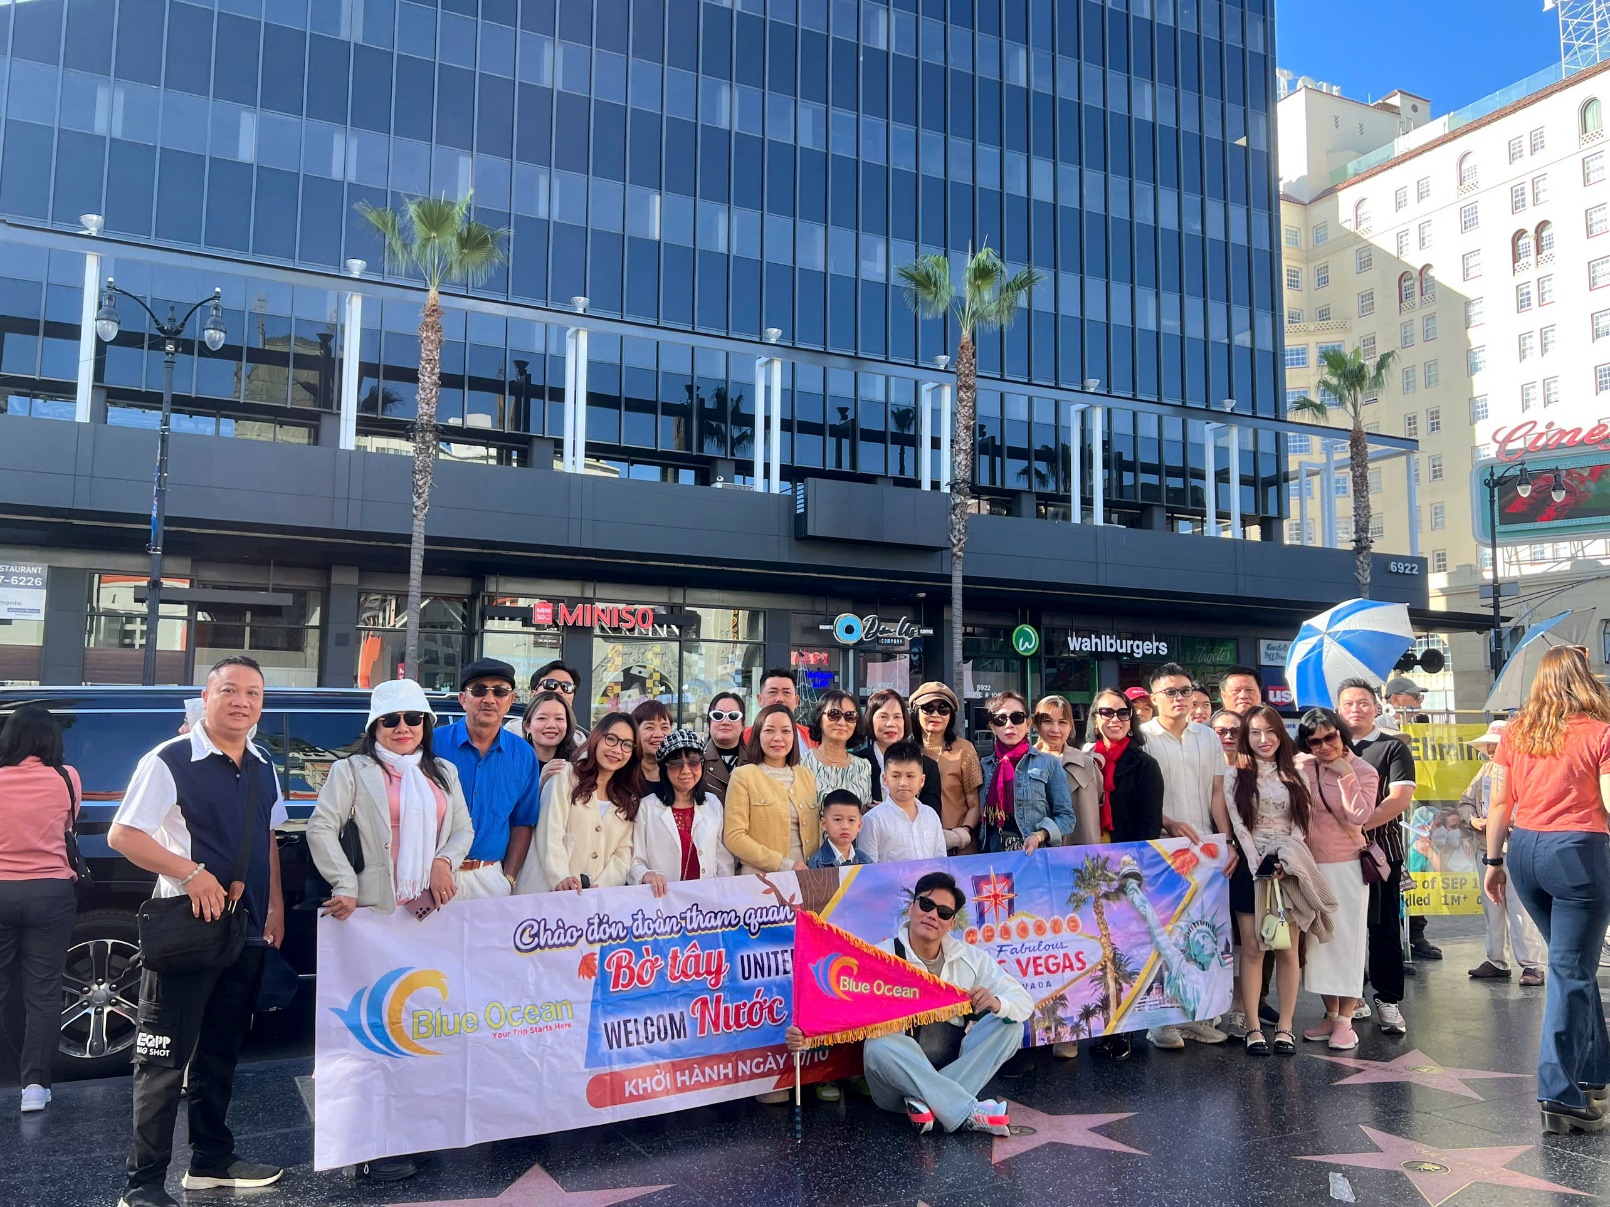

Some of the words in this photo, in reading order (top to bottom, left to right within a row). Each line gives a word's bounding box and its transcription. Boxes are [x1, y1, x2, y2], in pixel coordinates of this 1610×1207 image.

[1492, 420, 1610, 461] Cine
[1390, 561, 1419, 575] 6922
[559, 603, 654, 629] MINISO
[1067, 634, 1168, 658] wahlburgers
[1410, 736, 1484, 760] Elimin
[1422, 877, 1436, 889] of
[1441, 877, 1467, 889] SEP
[513, 917, 583, 952] Chào
[586, 912, 628, 945] đón
[631, 909, 683, 940] đoàn
[682, 903, 742, 934] tham
[743, 904, 796, 937] quan
[964, 913, 1081, 945] WELCOME
[996, 940, 1069, 958] Fabulous
[605, 945, 664, 991] Bờ
[668, 940, 730, 989] tây
[740, 948, 794, 981] UNITE
[1015, 951, 1087, 978] VEGAS
[840, 976, 870, 993] Blue
[873, 979, 919, 999] Ocean
[1022, 980, 1052, 990] VADA
[412, 1008, 480, 1040] Blue
[484, 999, 574, 1030] Ocean
[492, 1031, 511, 1039] Your
[513, 1028, 528, 1037] Trip
[530, 1025, 553, 1034] Starts
[554, 1022, 572, 1030] Here
[603, 1011, 688, 1051] WELCOM
[690, 987, 788, 1037] Nước
[149, 1048, 171, 1057] SHOT
[624, 1069, 671, 1097] KHỞI
[676, 1063, 732, 1087] HÀNH
[737, 1052, 787, 1077] NGÀY
